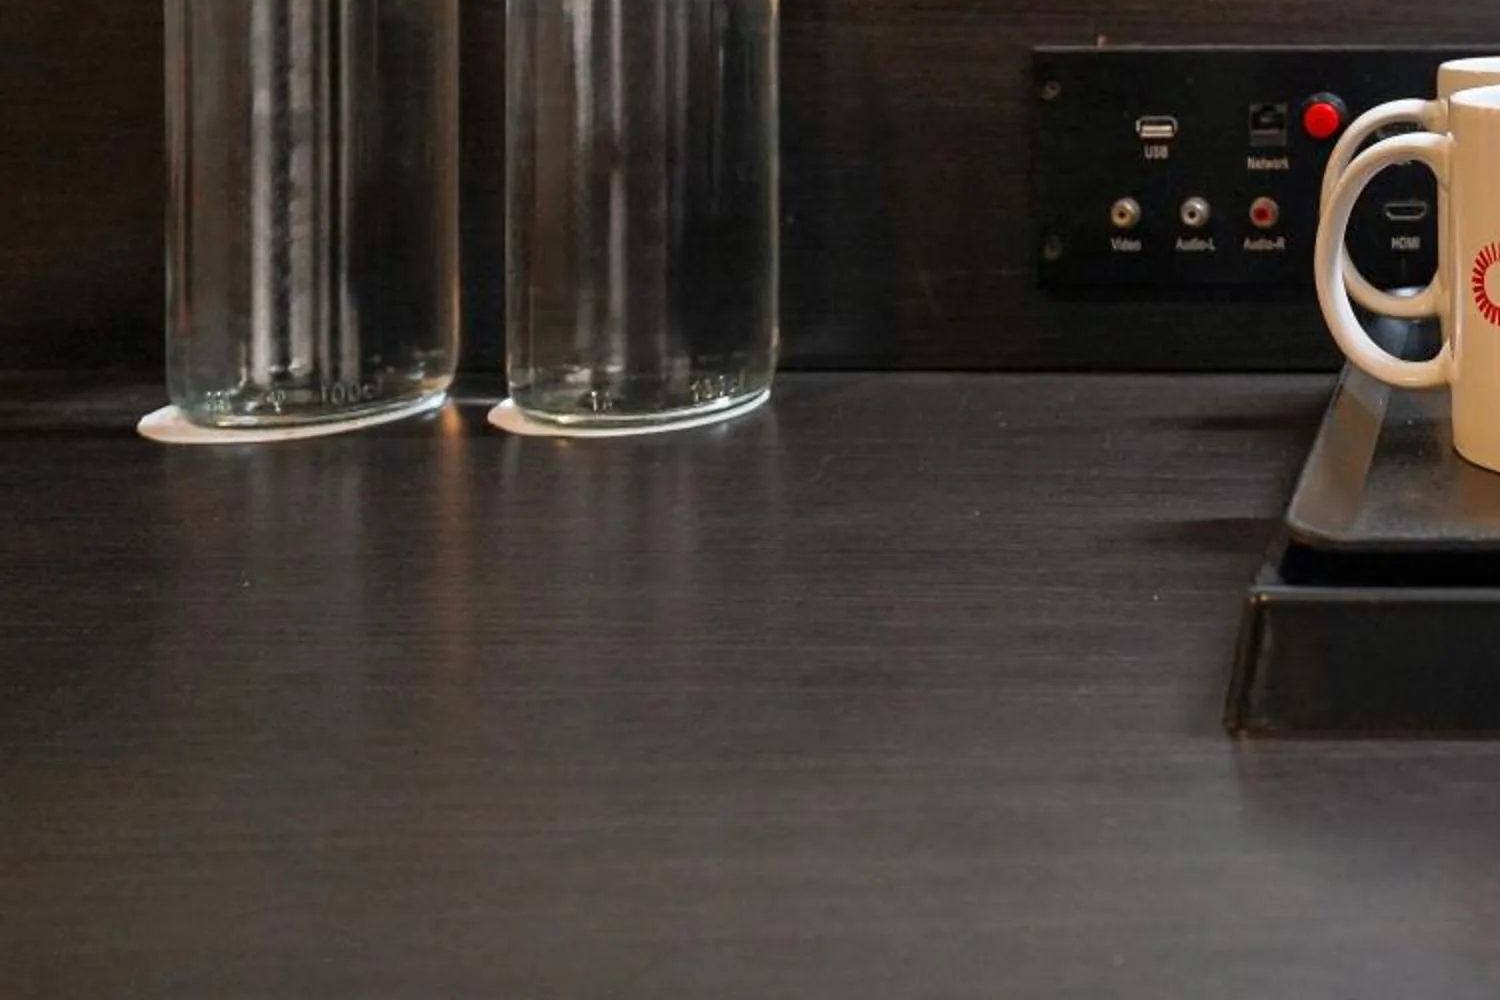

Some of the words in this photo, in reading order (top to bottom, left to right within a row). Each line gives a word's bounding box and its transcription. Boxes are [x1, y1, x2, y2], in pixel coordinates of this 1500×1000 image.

[1143, 144, 1170, 160] USB
[1246, 155, 1290, 170] Network
[1110, 236, 1143, 251] Video
[1175, 236, 1217, 251] Audio-L
[1242, 235, 1287, 251] Audio-R
[1390, 235, 1422, 251] HDMI
